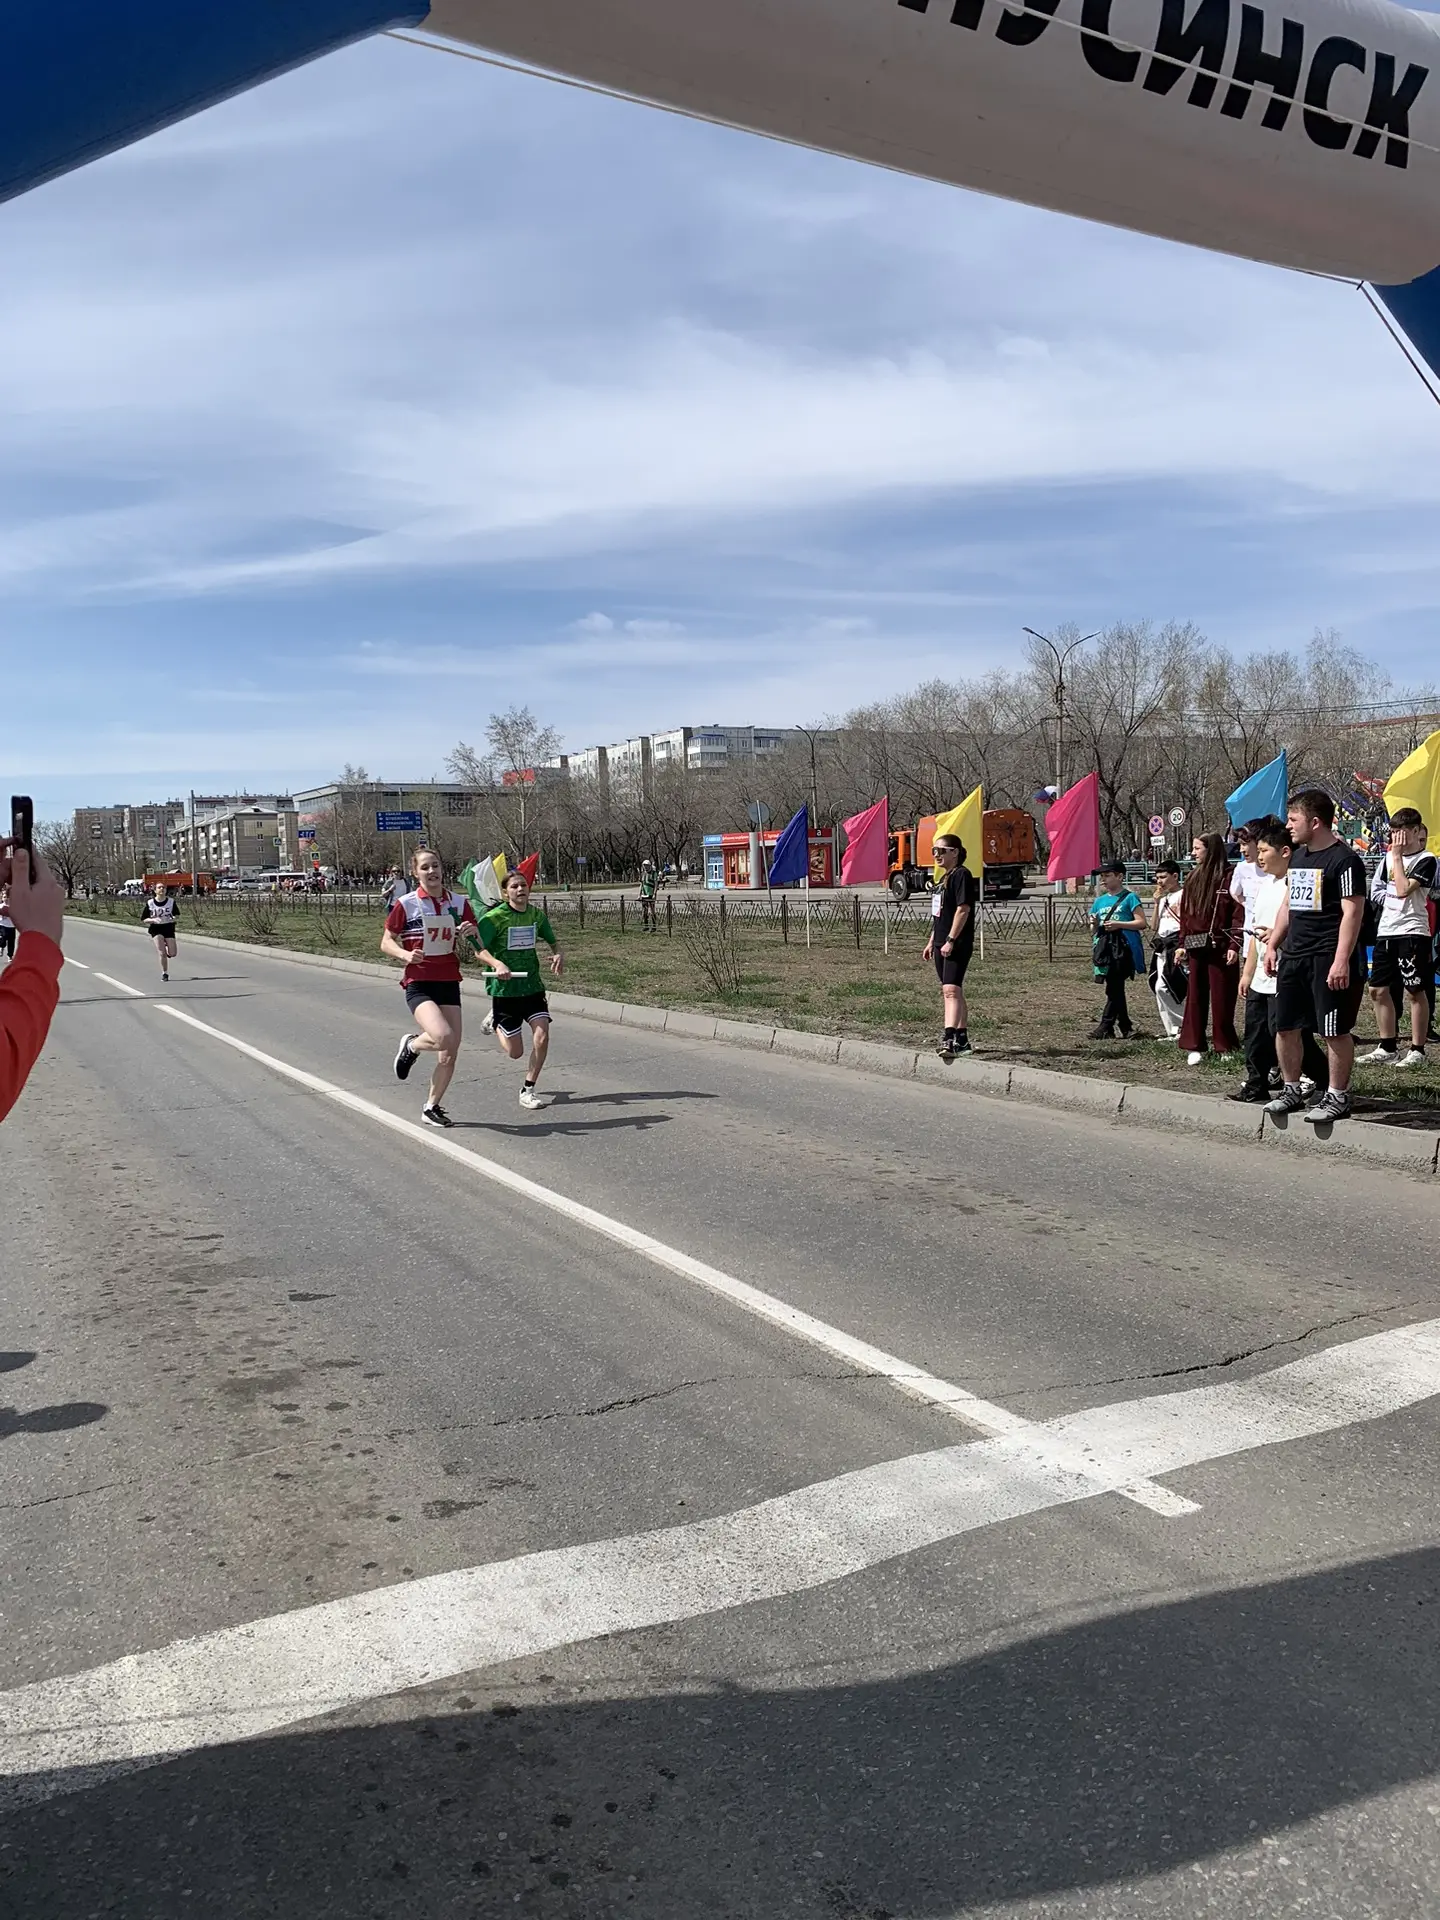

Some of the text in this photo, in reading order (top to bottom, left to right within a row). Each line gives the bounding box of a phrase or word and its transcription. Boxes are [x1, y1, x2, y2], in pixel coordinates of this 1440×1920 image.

[897, 0, 1429, 169] СИНСК
[1172, 813, 1182, 821] 20
[1290, 886, 1313, 900] 2372
[427, 927, 452, 941] 74
